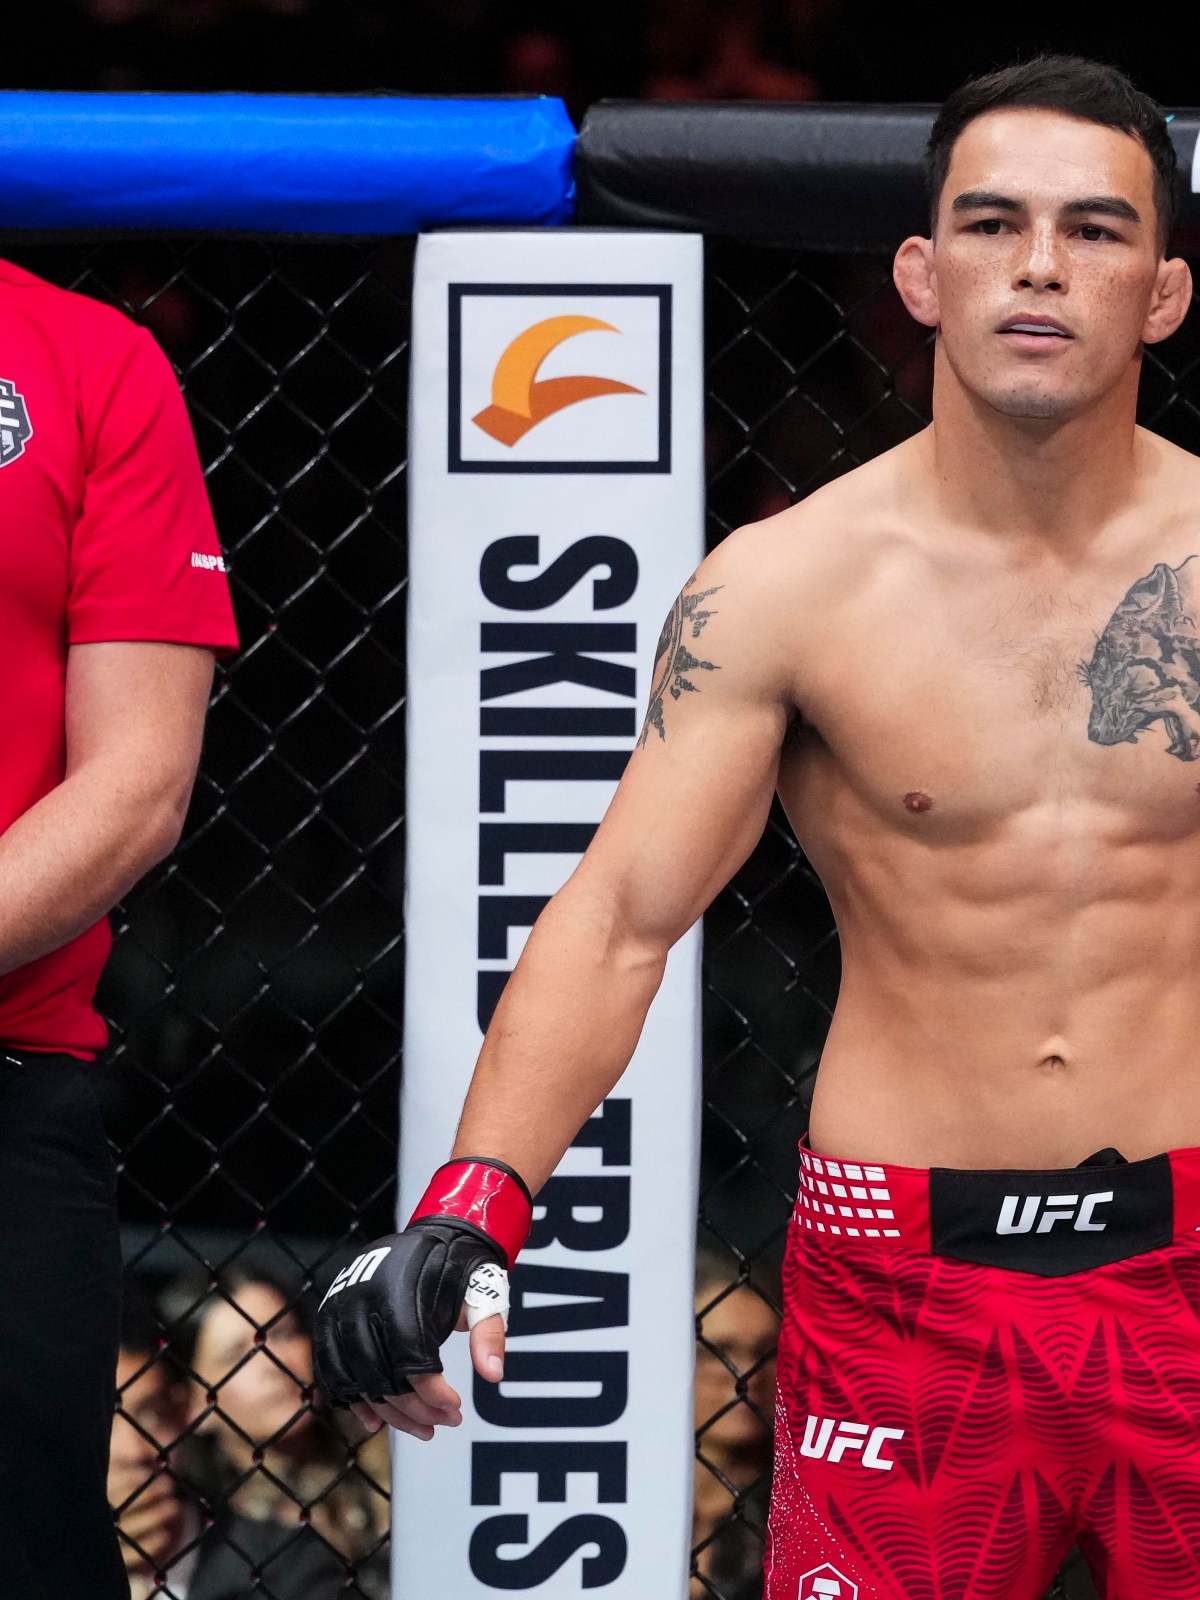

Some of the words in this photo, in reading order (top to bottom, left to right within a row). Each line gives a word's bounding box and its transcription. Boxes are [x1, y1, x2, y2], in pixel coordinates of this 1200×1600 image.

[996, 1191, 1114, 1235] UFC
[468, 1098, 632, 1590] TRADES
[799, 1415, 905, 1471] UFC
